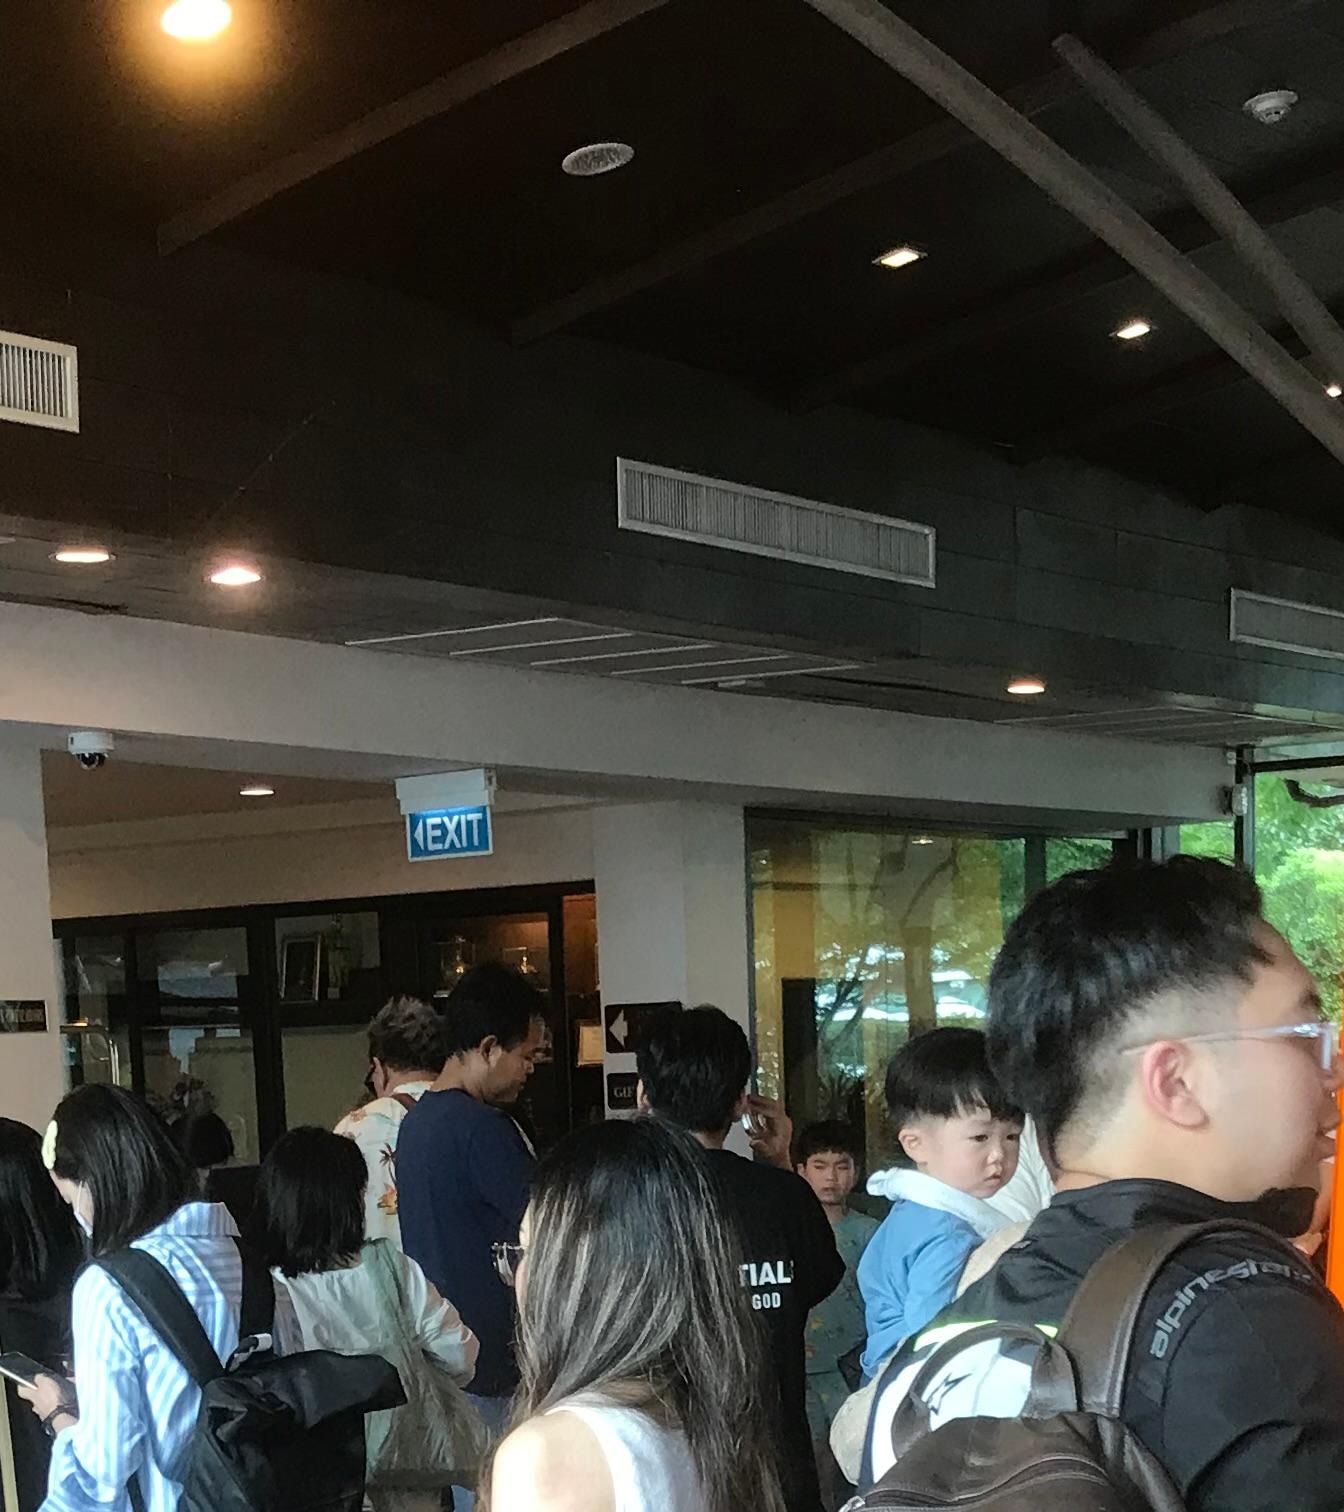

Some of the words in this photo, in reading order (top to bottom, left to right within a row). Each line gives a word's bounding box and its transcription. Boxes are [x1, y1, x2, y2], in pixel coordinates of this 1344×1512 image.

[426, 813, 483, 851] EXIT
[738, 1260, 794, 1287] TIAL
[751, 1292, 782, 1310] GOD
